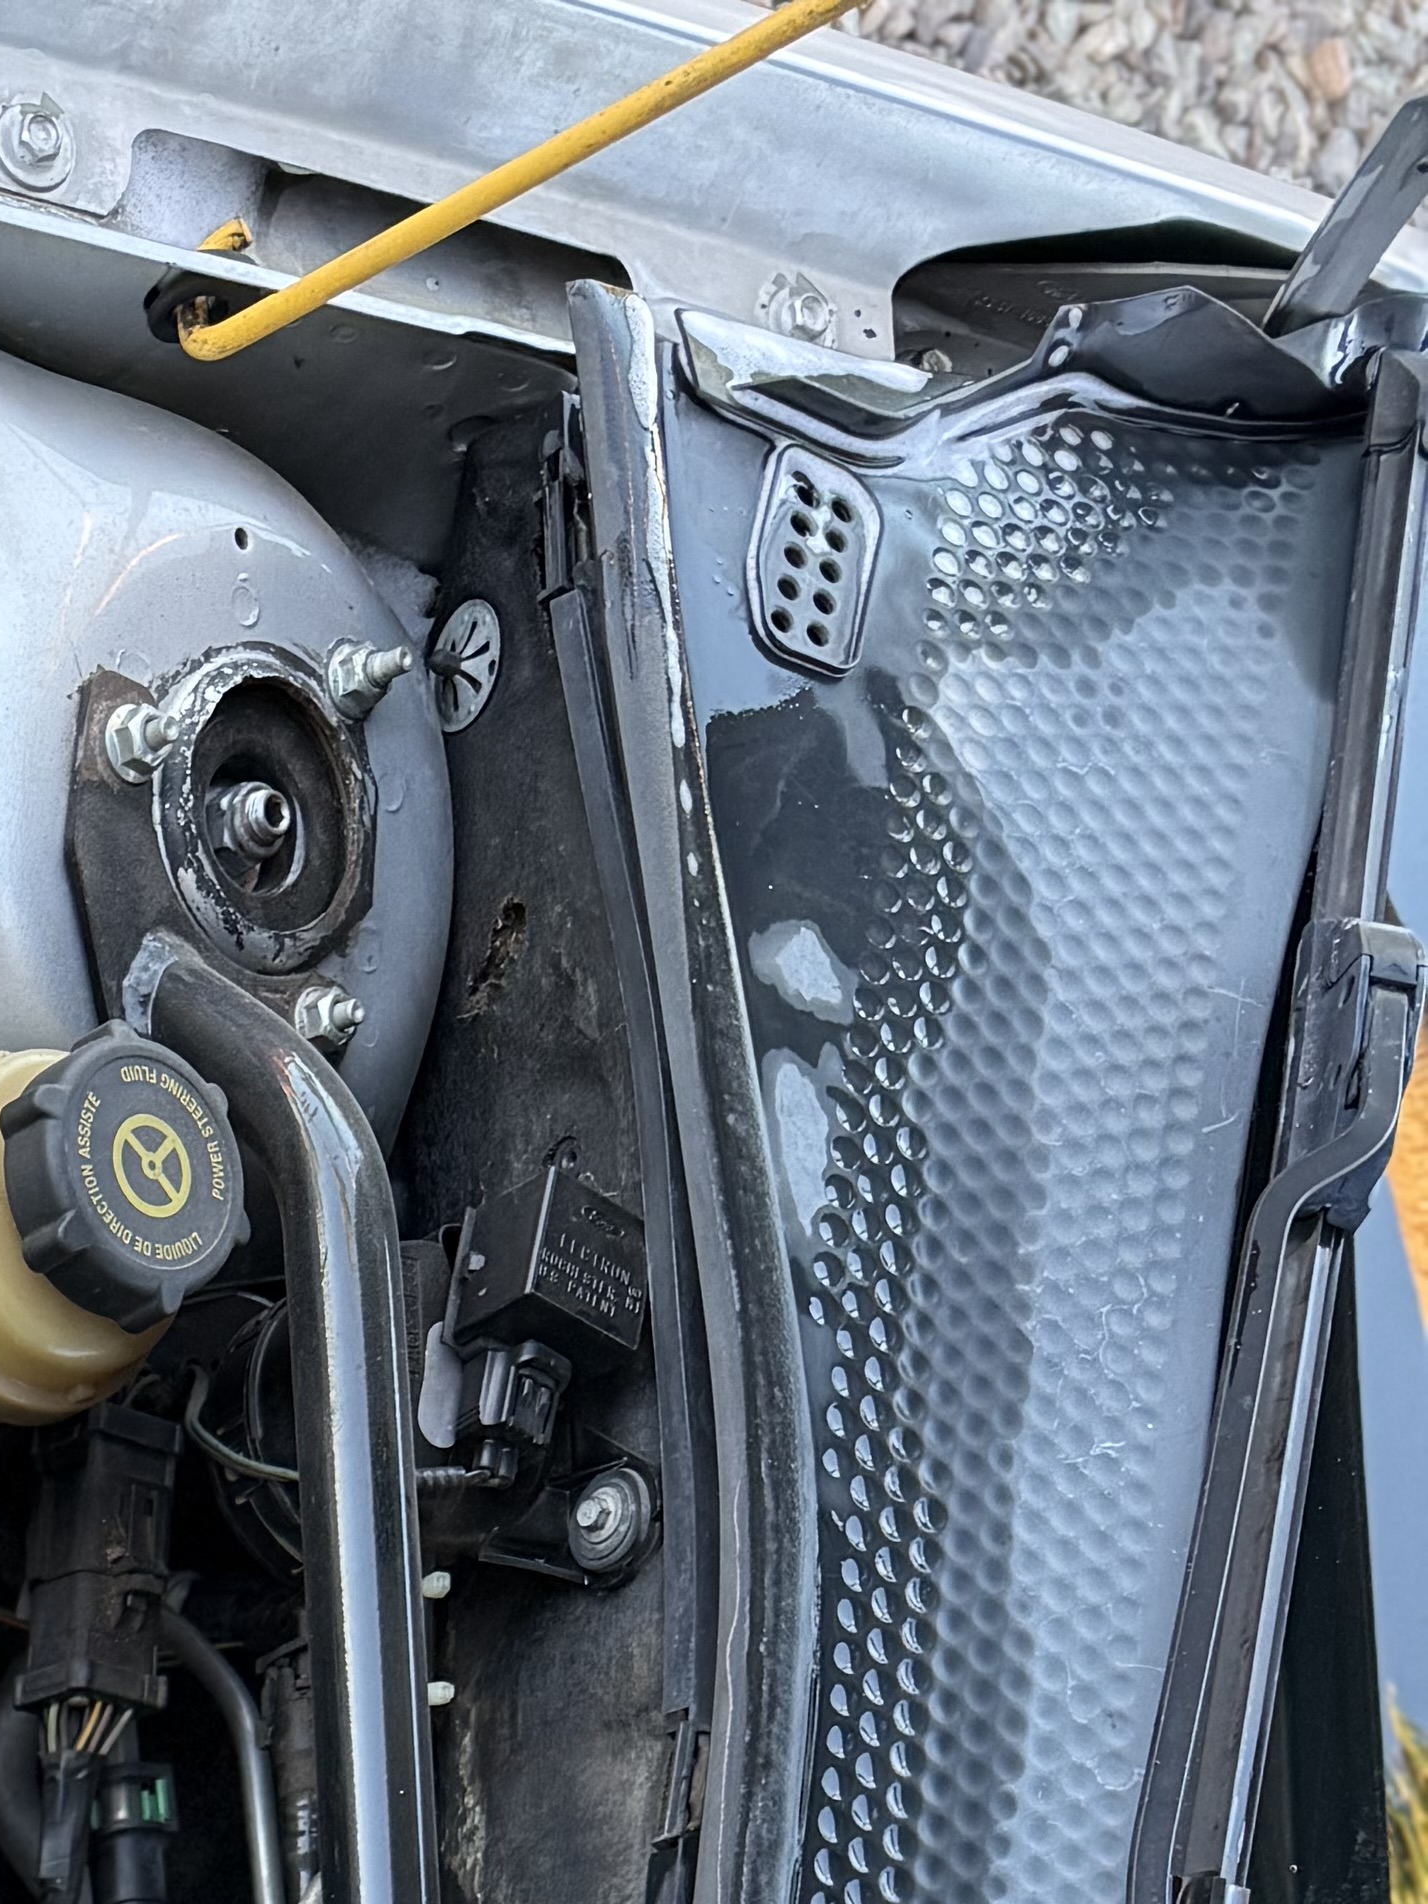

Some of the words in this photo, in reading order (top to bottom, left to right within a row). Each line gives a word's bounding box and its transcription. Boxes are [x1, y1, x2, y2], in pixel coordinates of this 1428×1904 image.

[120, 1065, 156, 1084] FLUID
[78, 1091, 101, 1159] ASSISTE
[160, 1074, 213, 1138] STEERING
[207, 1140, 224, 1201] POWER
[81, 1164, 133, 1245] DIRECTION
[134, 1236, 151, 1256] DE
[155, 1231, 203, 1260] LIQUIDE
